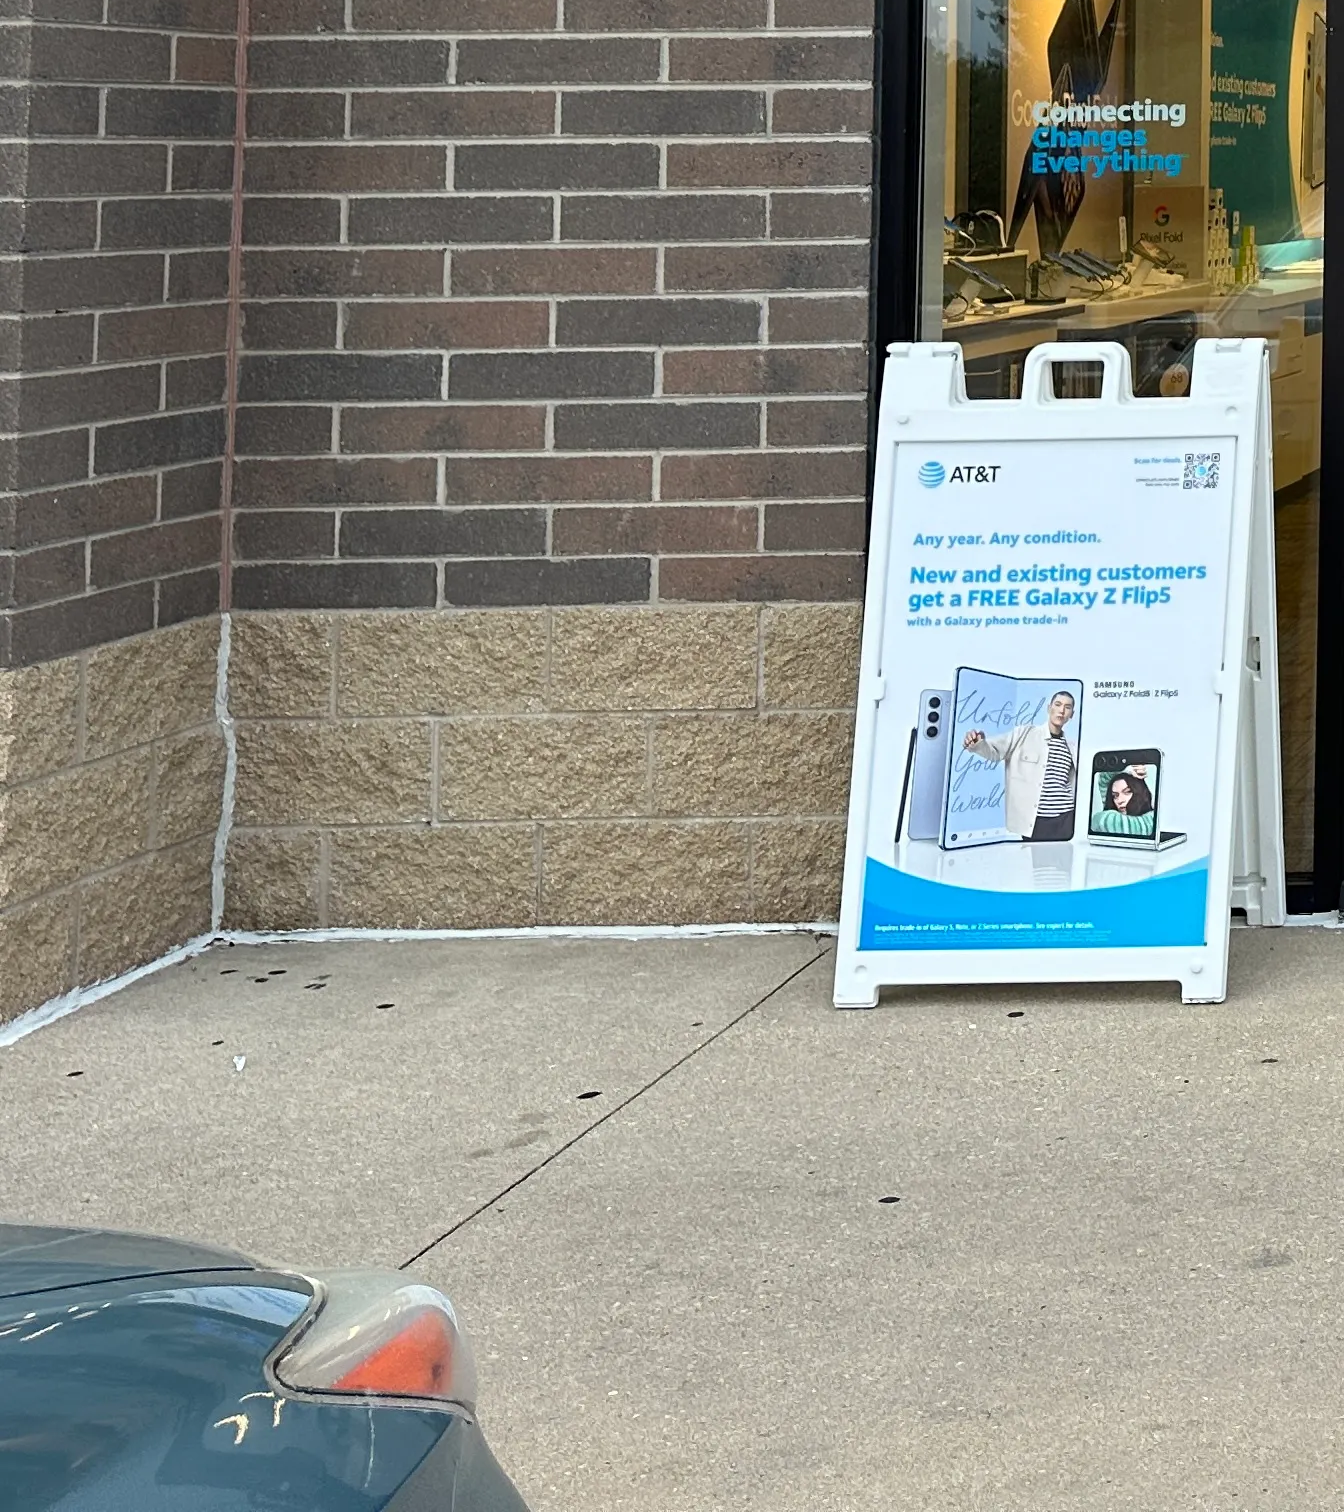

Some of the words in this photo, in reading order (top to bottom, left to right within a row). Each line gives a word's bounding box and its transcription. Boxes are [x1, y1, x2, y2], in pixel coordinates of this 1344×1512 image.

[1032, 98, 1186, 127] Connecting
[1032, 126, 1147, 152] Changes
[1032, 149, 1182, 178] Everything
[949, 465, 1001, 484] AT&T
[913, 533, 944, 547] Any
[947, 534, 986, 549] year.
[989, 532, 1019, 548] Any
[1023, 530, 1102, 544] condition.
[910, 566, 956, 584] New
[962, 565, 1001, 583] and
[1007, 564, 1091, 586] existing
[1097, 563, 1207, 581] customers
[908, 589, 944, 612] get
[949, 592, 962, 607] a
[968, 589, 1020, 606] FREE
[1025, 588, 1099, 610] Galaxy
[1103, 588, 1116, 605] Z
[1122, 586, 1171, 608] Flip5
[907, 616, 932, 627] with
[944, 616, 982, 628] Galaxy
[985, 616, 1020, 628] phone
[1022, 614, 1068, 626] trade-in
[1093, 690, 1121, 700] Galaxy
[1094, 680, 1135, 688] SAMSUNG
[957, 690, 1046, 728] Unfold
[951, 783, 1005, 813] world
